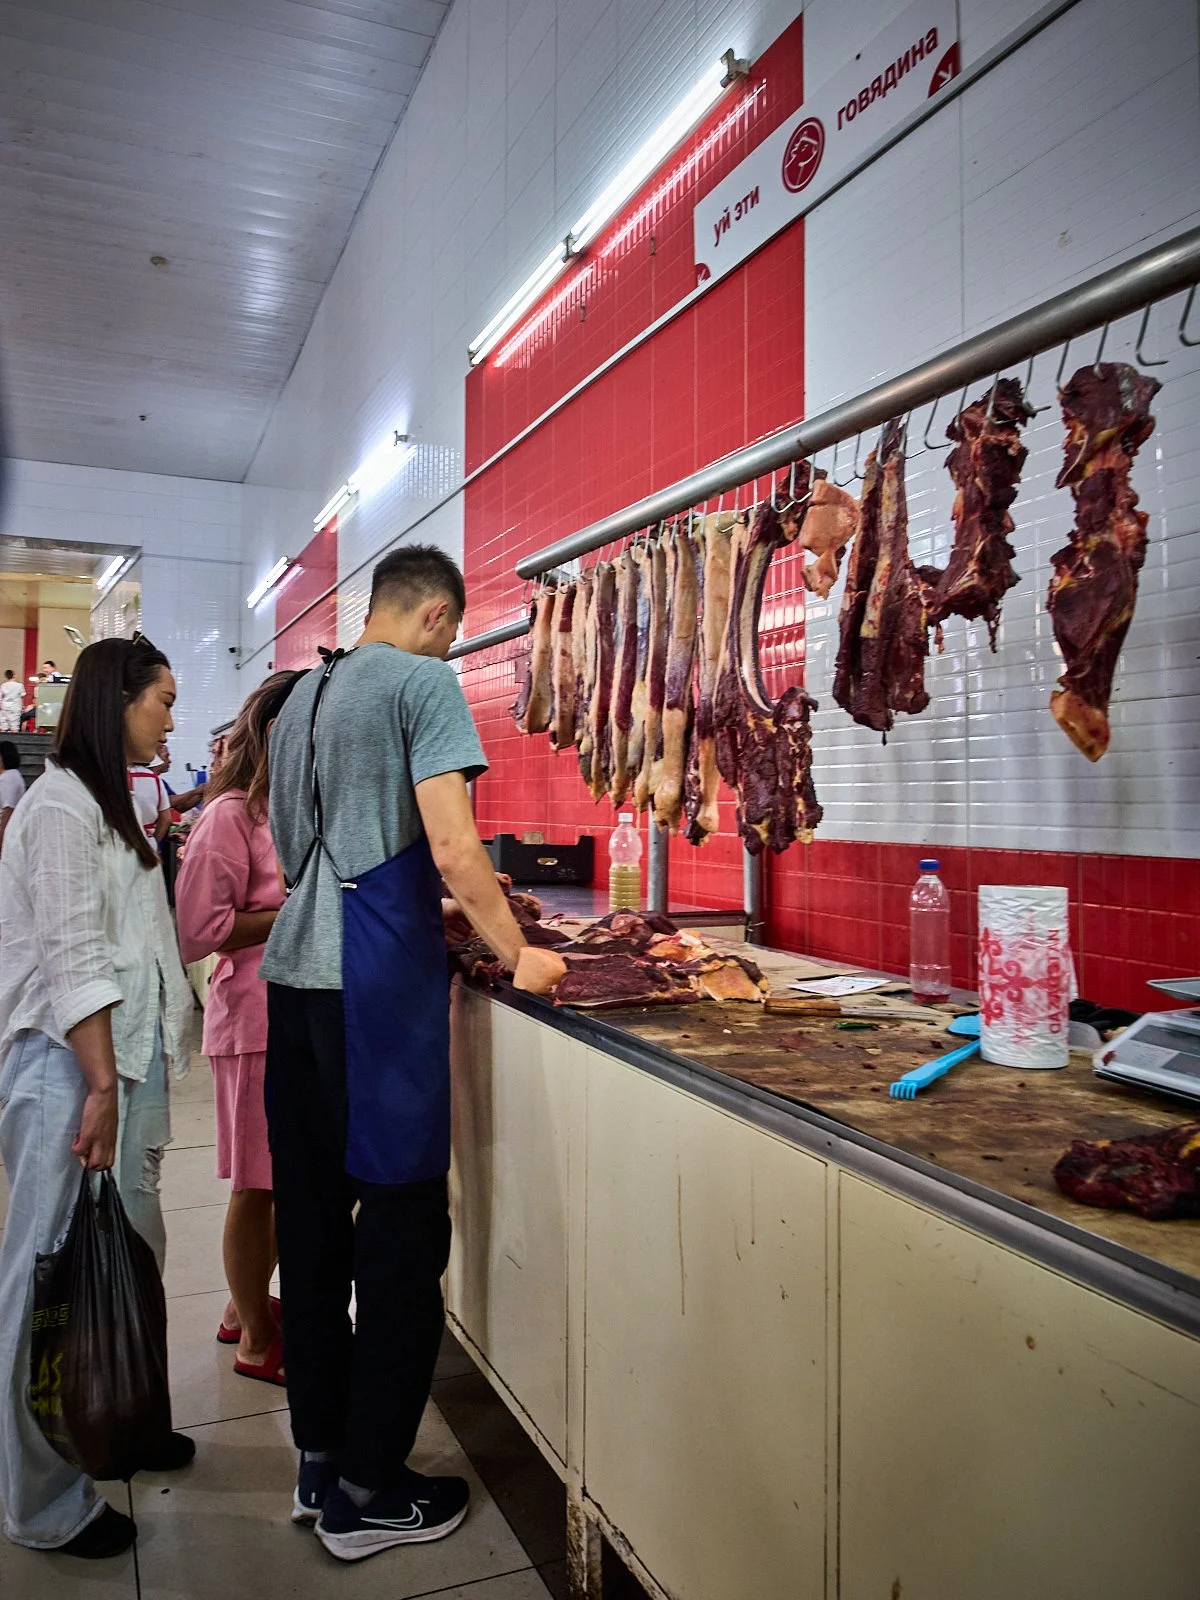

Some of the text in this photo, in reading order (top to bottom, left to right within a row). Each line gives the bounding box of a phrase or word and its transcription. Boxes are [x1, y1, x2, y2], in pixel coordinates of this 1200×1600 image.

[837, 26, 939, 131] говядина
[713, 185, 760, 248] уй эти
